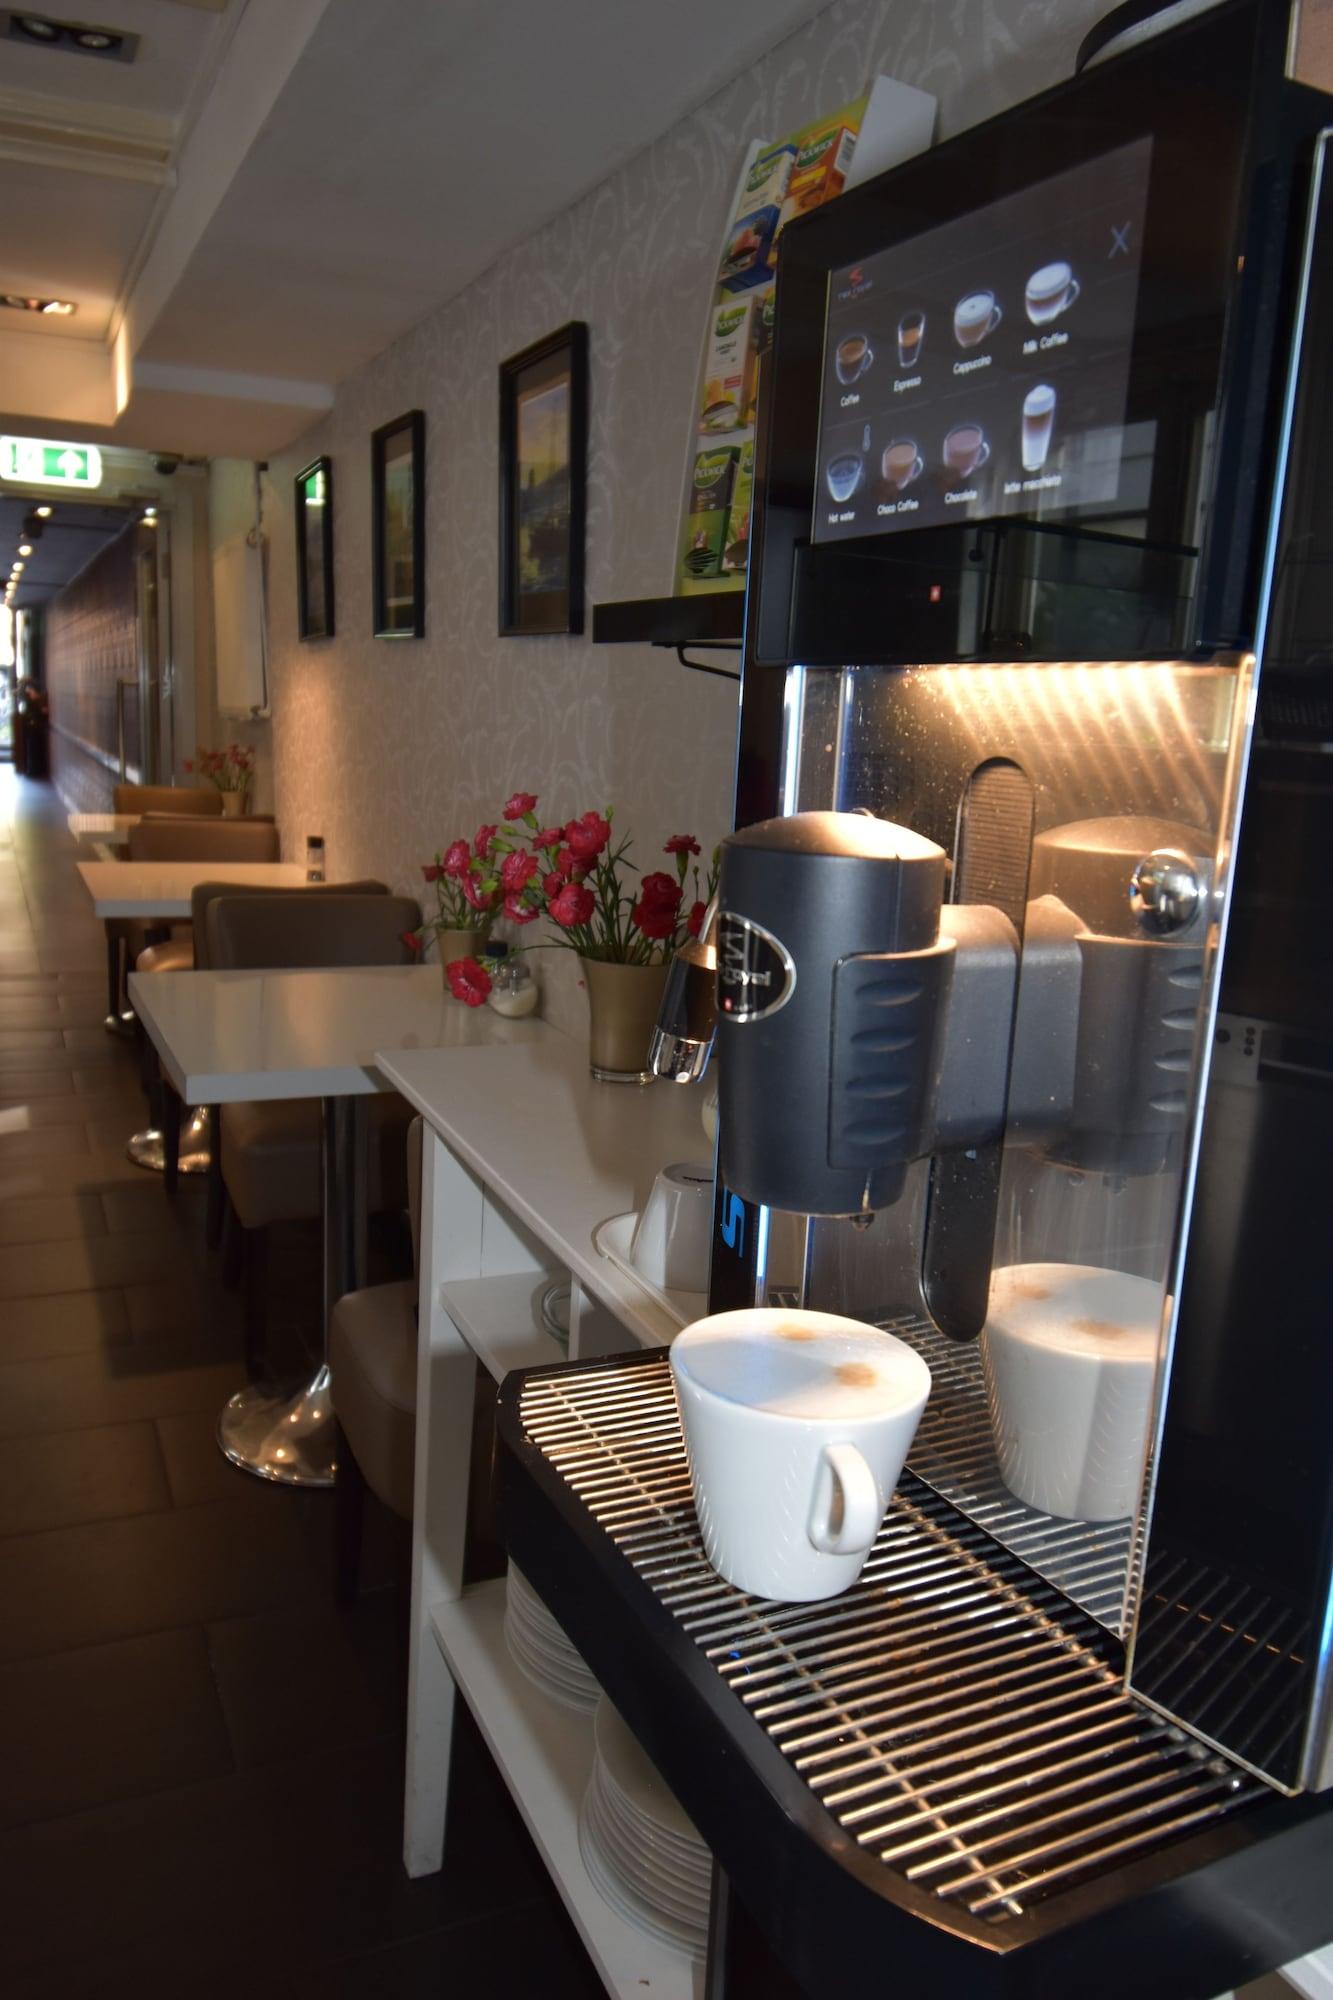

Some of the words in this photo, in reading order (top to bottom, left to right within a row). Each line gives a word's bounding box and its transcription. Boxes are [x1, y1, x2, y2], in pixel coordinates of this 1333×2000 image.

[1040, 332, 1069, 350] Coffee
[953, 355, 992, 375] Cappuccino
[893, 376, 922, 392] Espresso
[840, 394, 860, 407] Coffee
